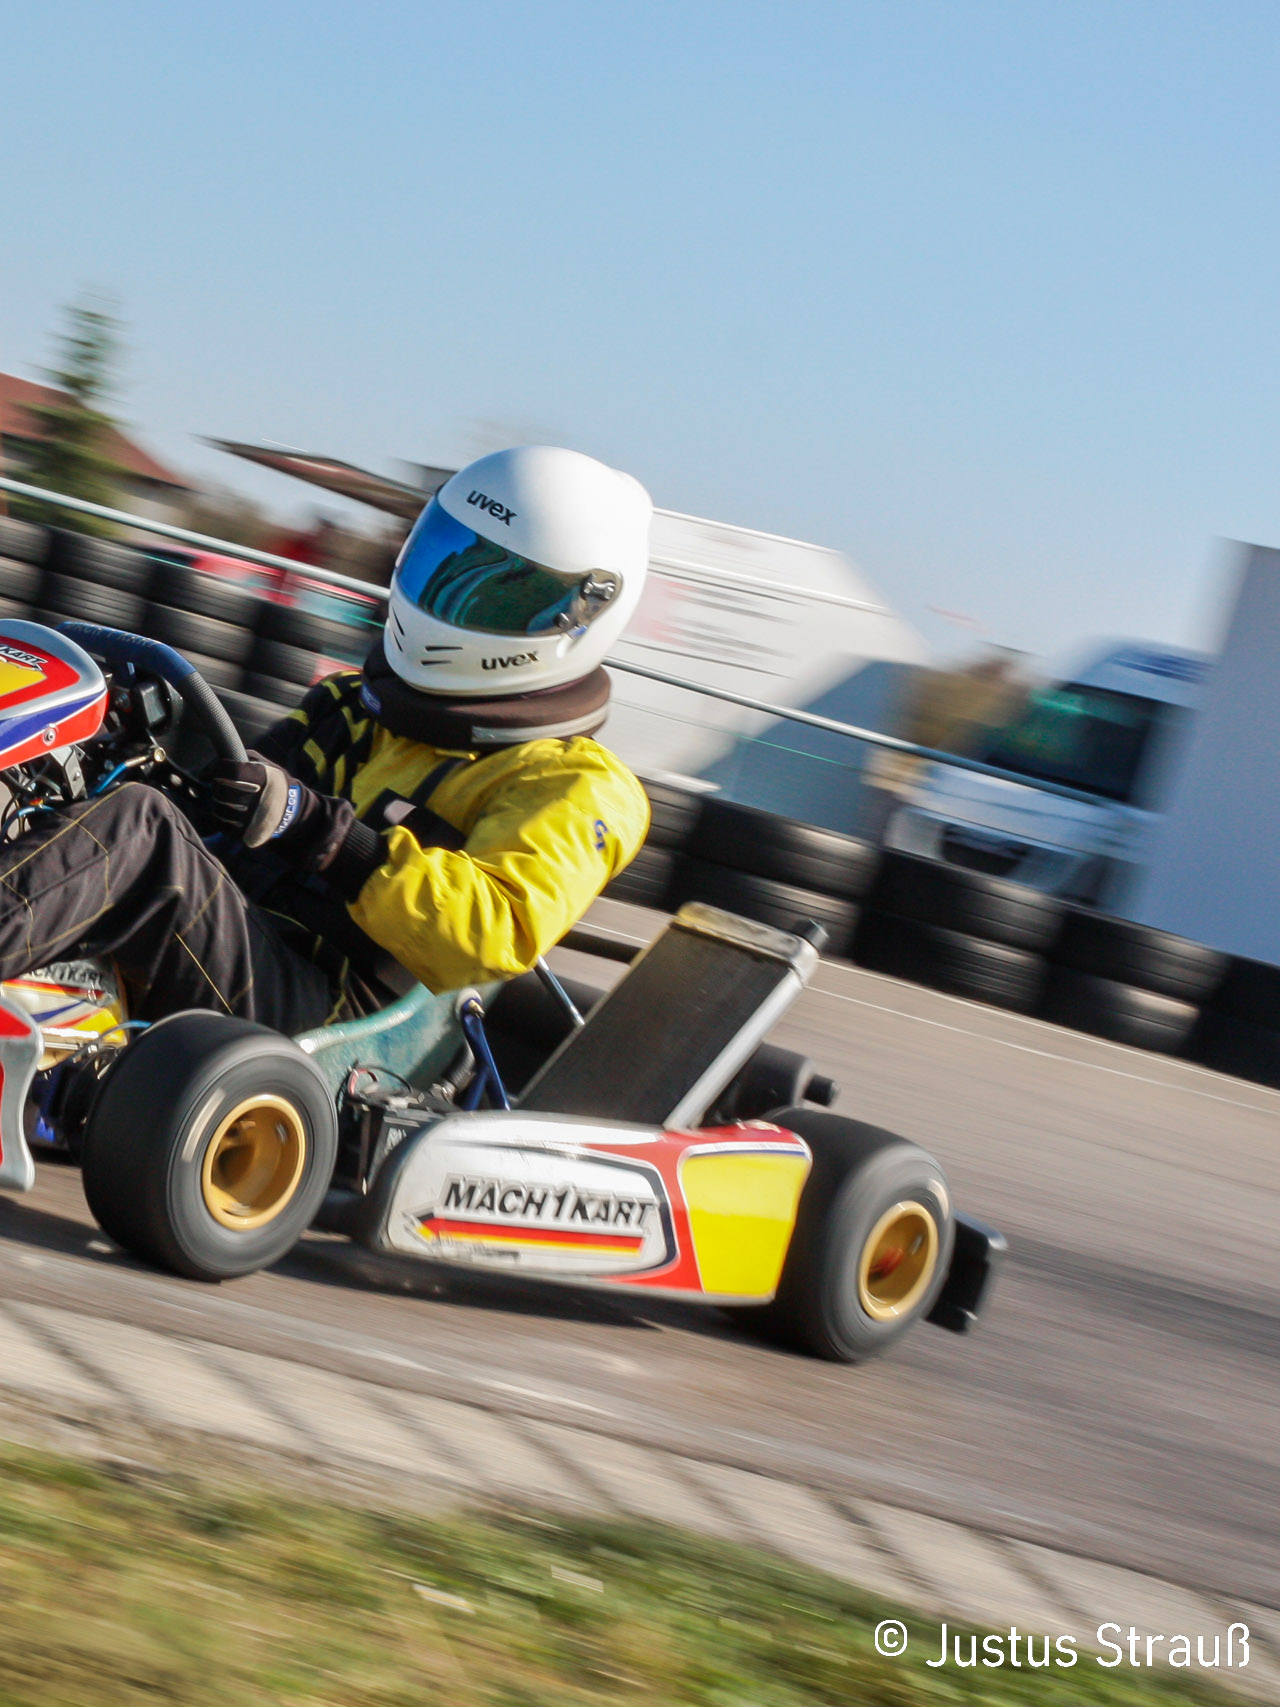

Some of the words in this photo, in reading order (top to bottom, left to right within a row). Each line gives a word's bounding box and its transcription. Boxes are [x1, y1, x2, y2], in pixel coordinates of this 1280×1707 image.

[466, 490, 518, 527] uvex
[481, 650, 539, 671] uvex
[443, 1181, 657, 1226] MACH1KART
